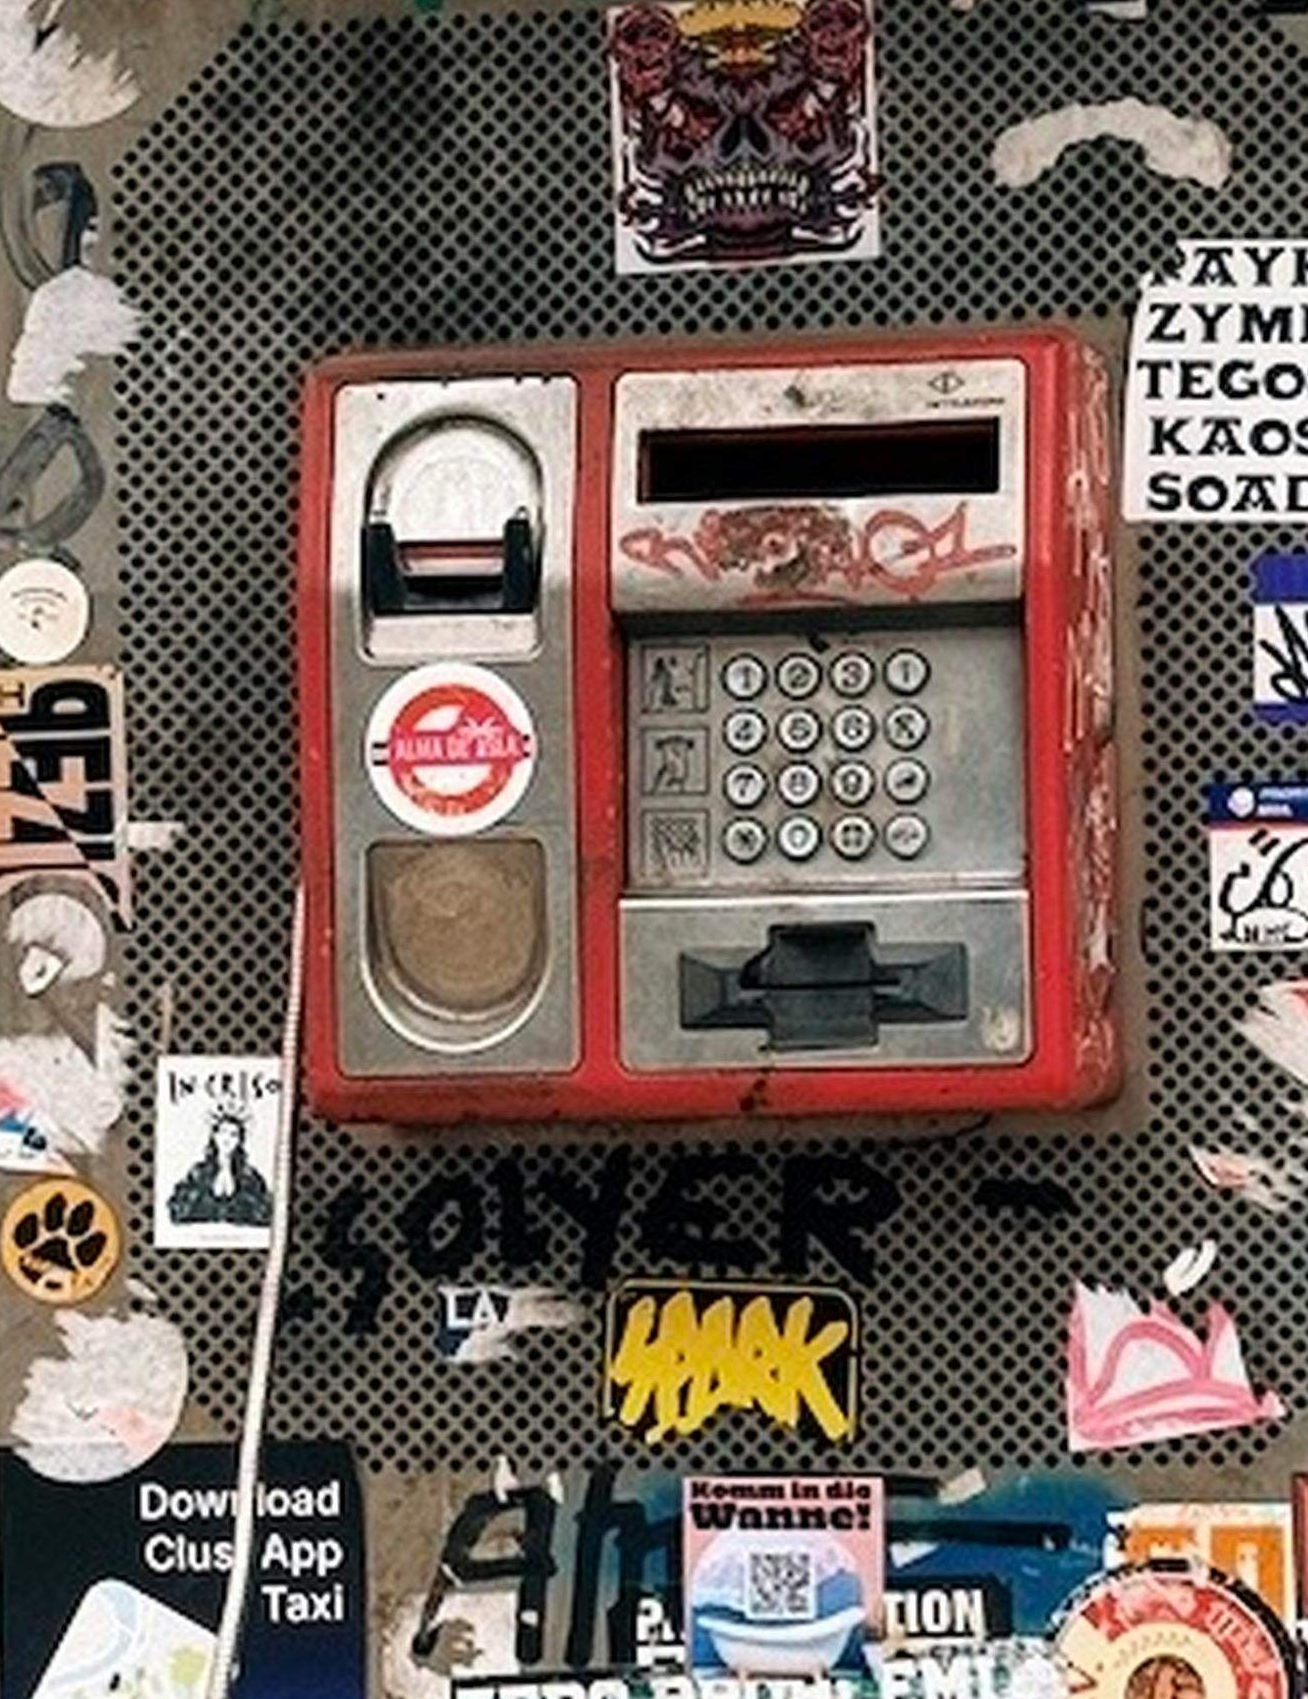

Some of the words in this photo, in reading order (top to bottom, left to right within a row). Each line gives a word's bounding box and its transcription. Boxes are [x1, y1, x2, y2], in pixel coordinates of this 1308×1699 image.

[691, 1480, 786, 1500] Komm
[791, 1480, 820, 1500] in
[691, 1502, 871, 1531] Wanne!
[260, 1533, 346, 1577] App
[260, 1584, 346, 1623] Taxi
